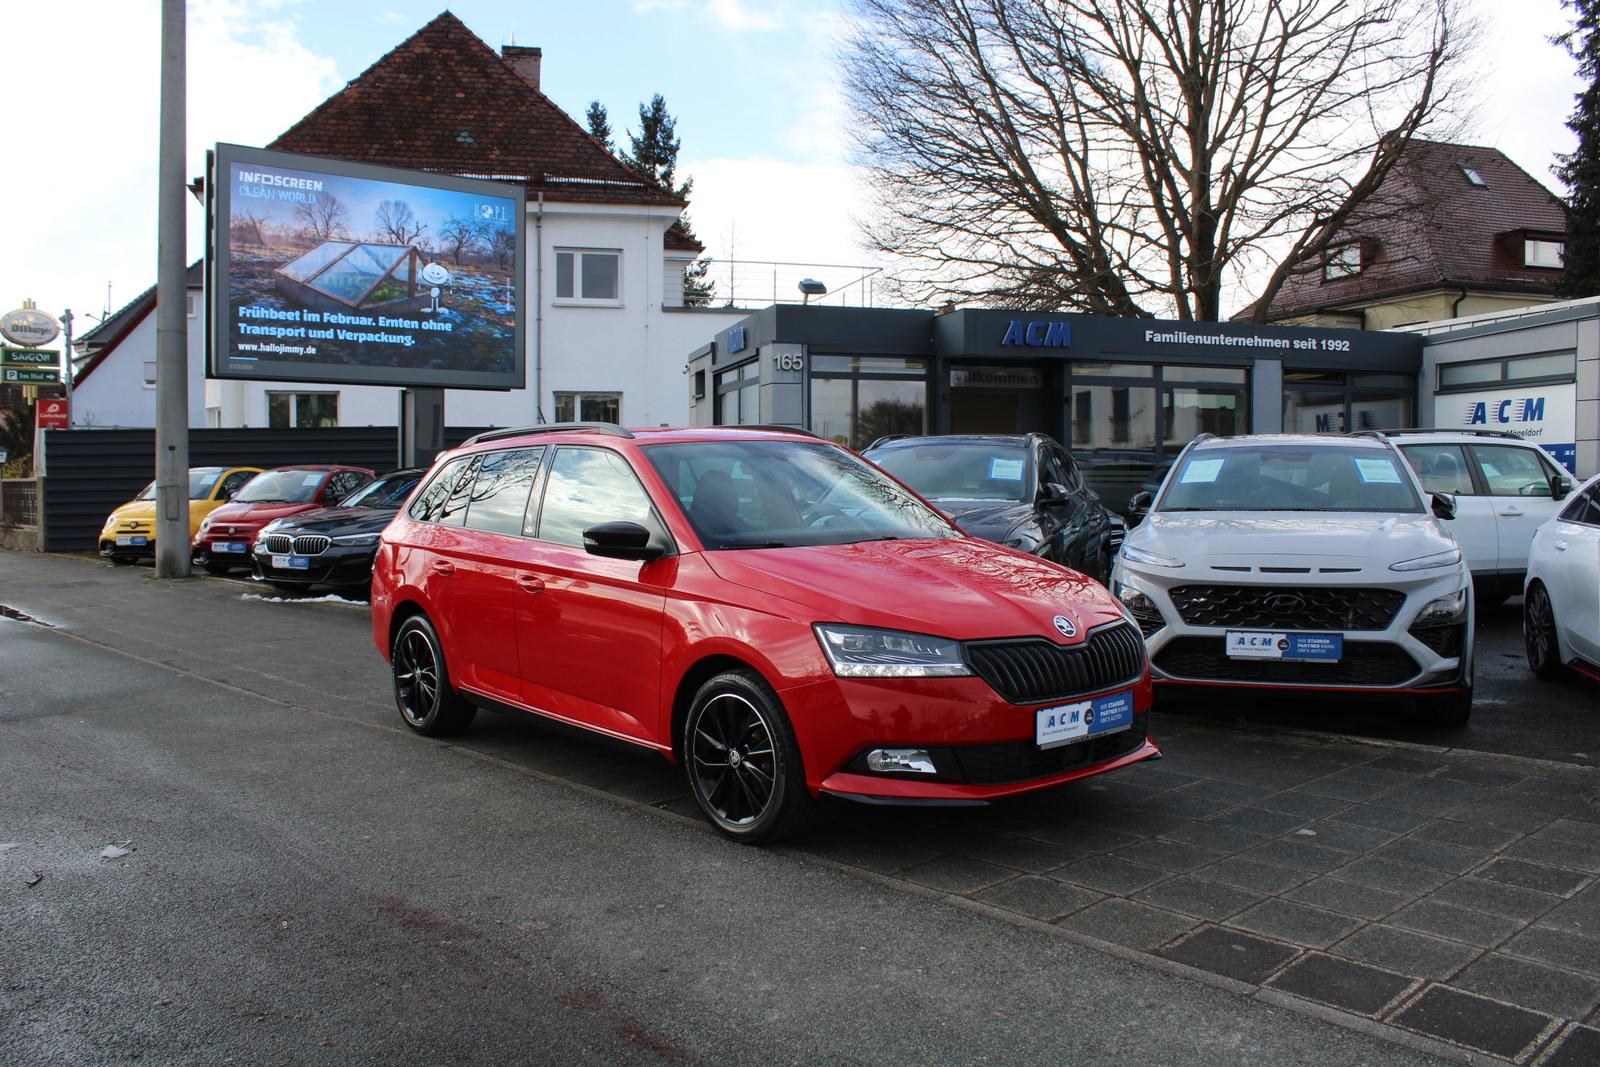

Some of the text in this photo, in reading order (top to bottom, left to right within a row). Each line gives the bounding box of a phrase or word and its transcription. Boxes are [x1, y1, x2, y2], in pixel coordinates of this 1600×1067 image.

[240, 171, 323, 191] INFOSCREEN
[239, 185, 316, 204] CLEAN WORLD
[238, 306, 452, 332] Frühbeet im Februar. Ernten ohne
[238, 323, 415, 346] Transport und Verpackung.
[1001, 320, 1072, 347] ACM
[1145, 330, 1350, 351] Familienunternehmen seit 1992
[11, 352, 50, 361] SAIGON
[238, 342, 316, 355] www.hallojimmy.de
[774, 353, 803, 371] 165
[1467, 397, 1545, 424] ACM
[1236, 637, 1272, 647] ACM
[1046, 710, 1080, 728] ACM
